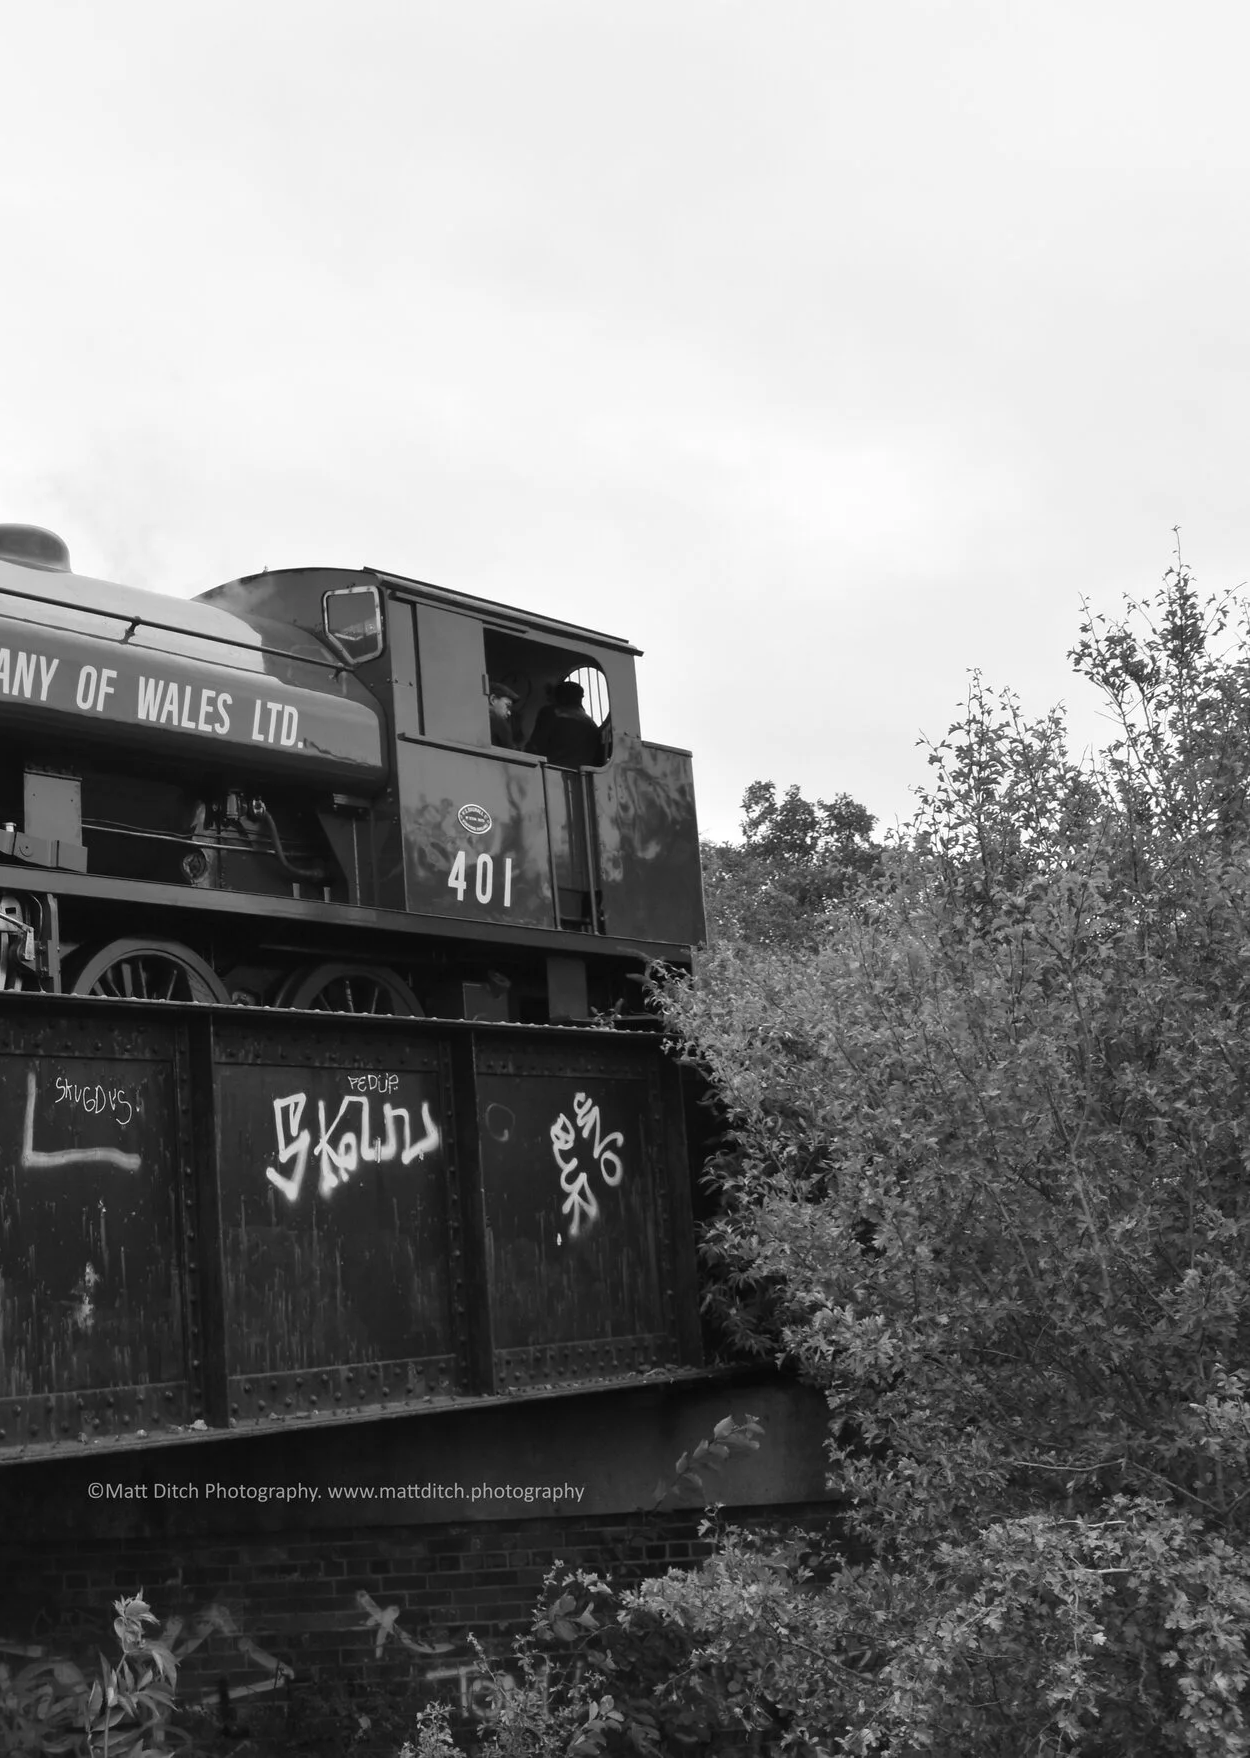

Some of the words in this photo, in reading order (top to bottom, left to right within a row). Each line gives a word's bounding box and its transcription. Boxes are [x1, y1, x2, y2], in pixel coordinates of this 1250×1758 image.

[77, 666, 118, 712] OF
[138, 677, 231, 735] WALES
[252, 699, 304, 749] LTD.
[448, 850, 512, 907] 401
